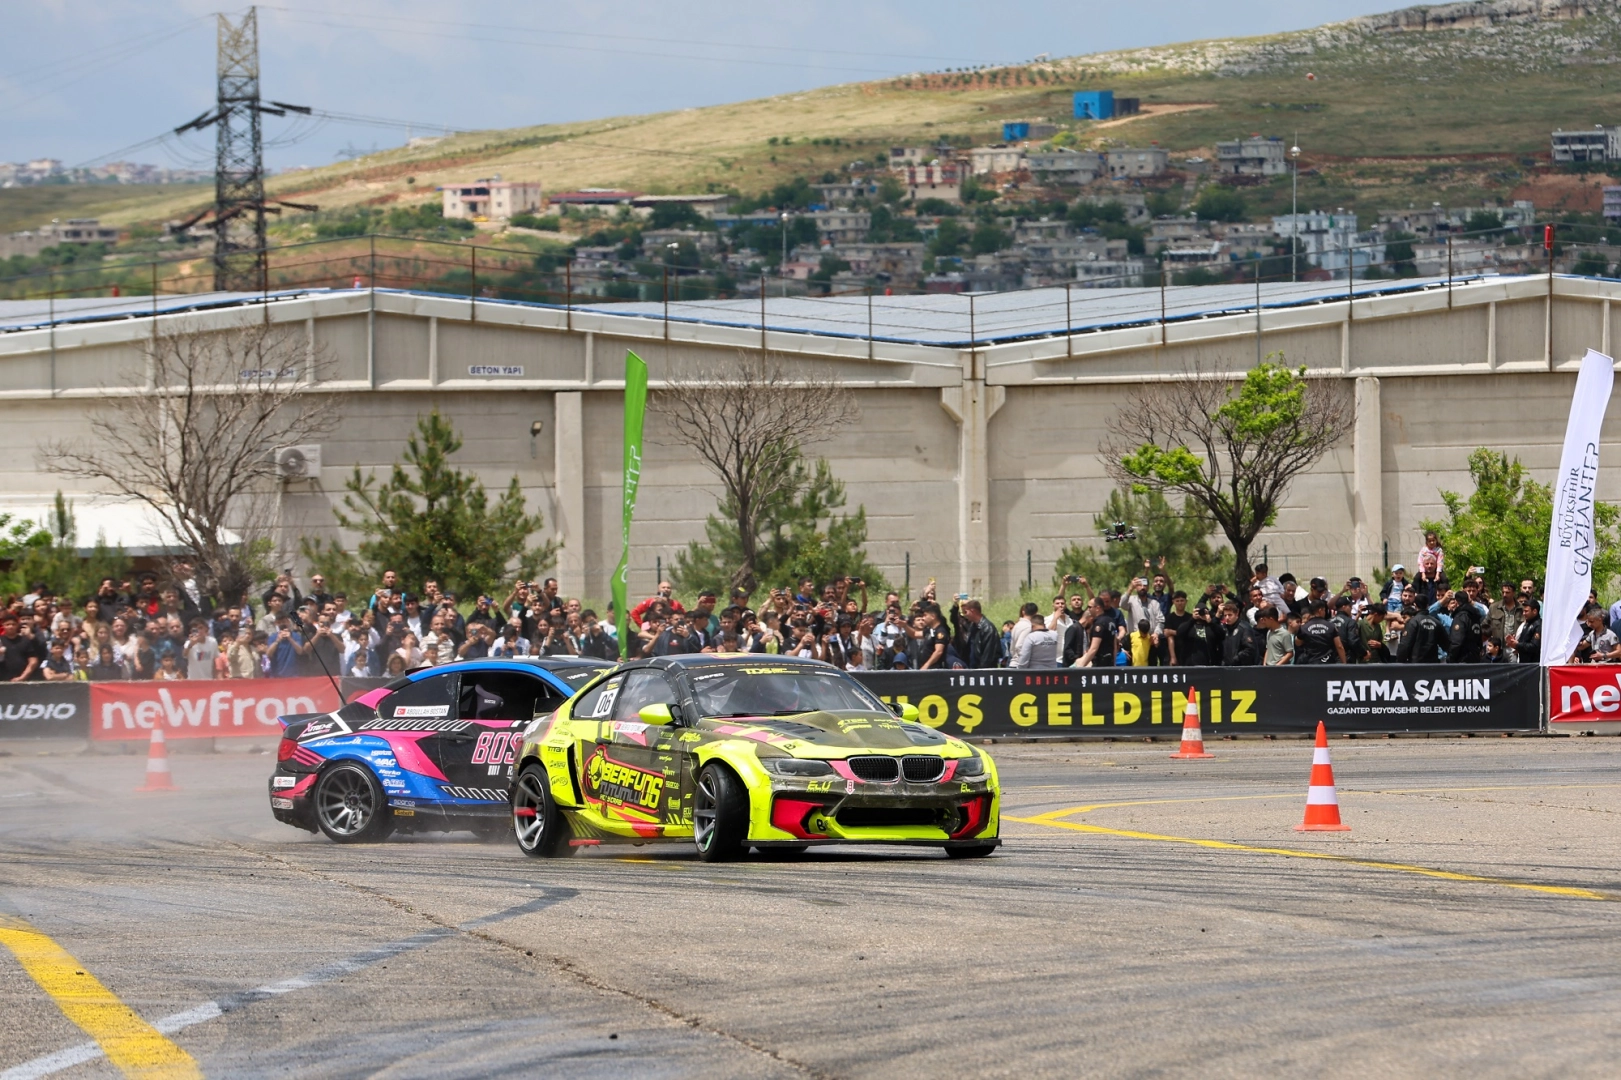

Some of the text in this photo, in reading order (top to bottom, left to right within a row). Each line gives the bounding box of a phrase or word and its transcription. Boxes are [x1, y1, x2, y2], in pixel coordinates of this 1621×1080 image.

[470, 366, 522, 375] BETON YAPI
[950, 673, 1186, 687] TÜRKİYE DRIFT ŞAMPİYONASI
[1327, 678, 1490, 702] FATMA ŞAHİN
[597, 692, 614, 714] 06
[1457, 705, 1490, 713] BAŞKANI
[600, 781, 641, 804] TUTUMLU
